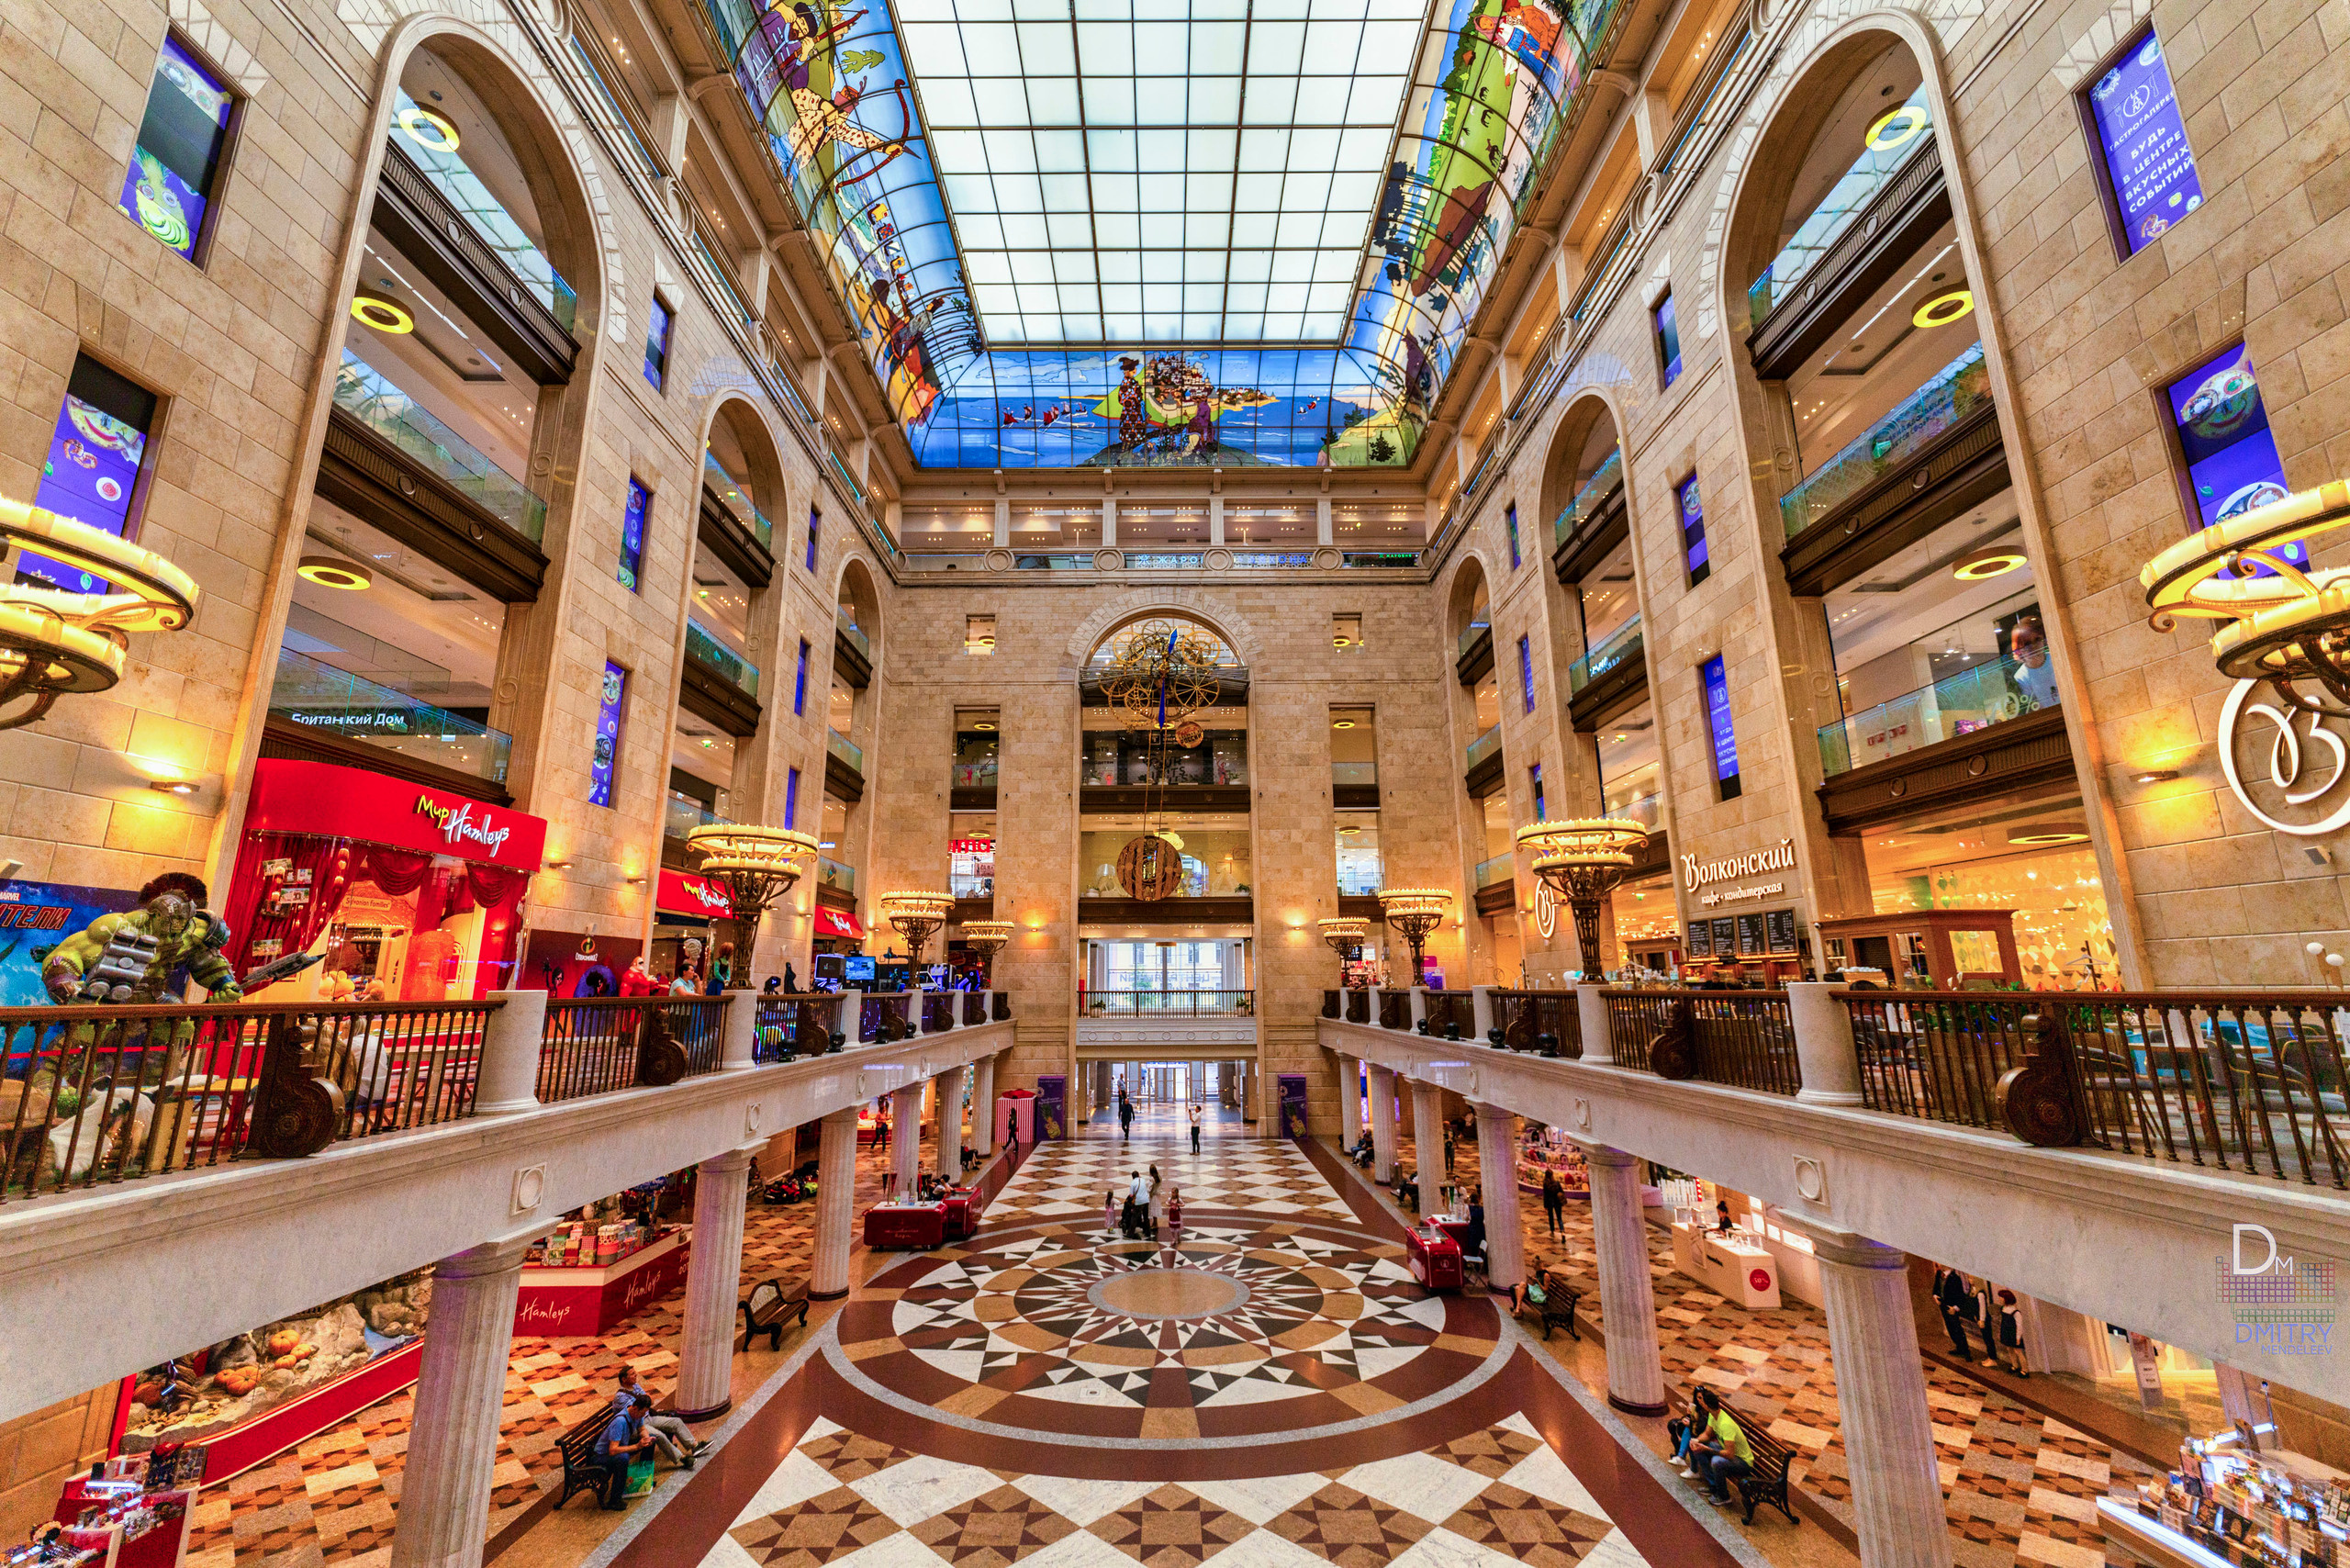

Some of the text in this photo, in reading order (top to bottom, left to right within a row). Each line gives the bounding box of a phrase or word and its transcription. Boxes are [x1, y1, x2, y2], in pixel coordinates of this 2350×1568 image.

[2123, 130, 2182, 185] В ЦЕНТРЕ
[2131, 127, 2166, 160] БУДЬ
[2125, 144, 2189, 201] ВКУСНЫХ
[2129, 156, 2194, 213] СОБЫТИЙ
[292, 712, 404, 726] Британкий Дом
[418, 795, 509, 857] Мир Hamleys
[1680, 838, 1794, 892] Волконский
[1701, 882, 1784, 906] кафе кондитерская
[520, 1296, 570, 1327] Hamleys
[623, 1270, 661, 1311] Hamleys
